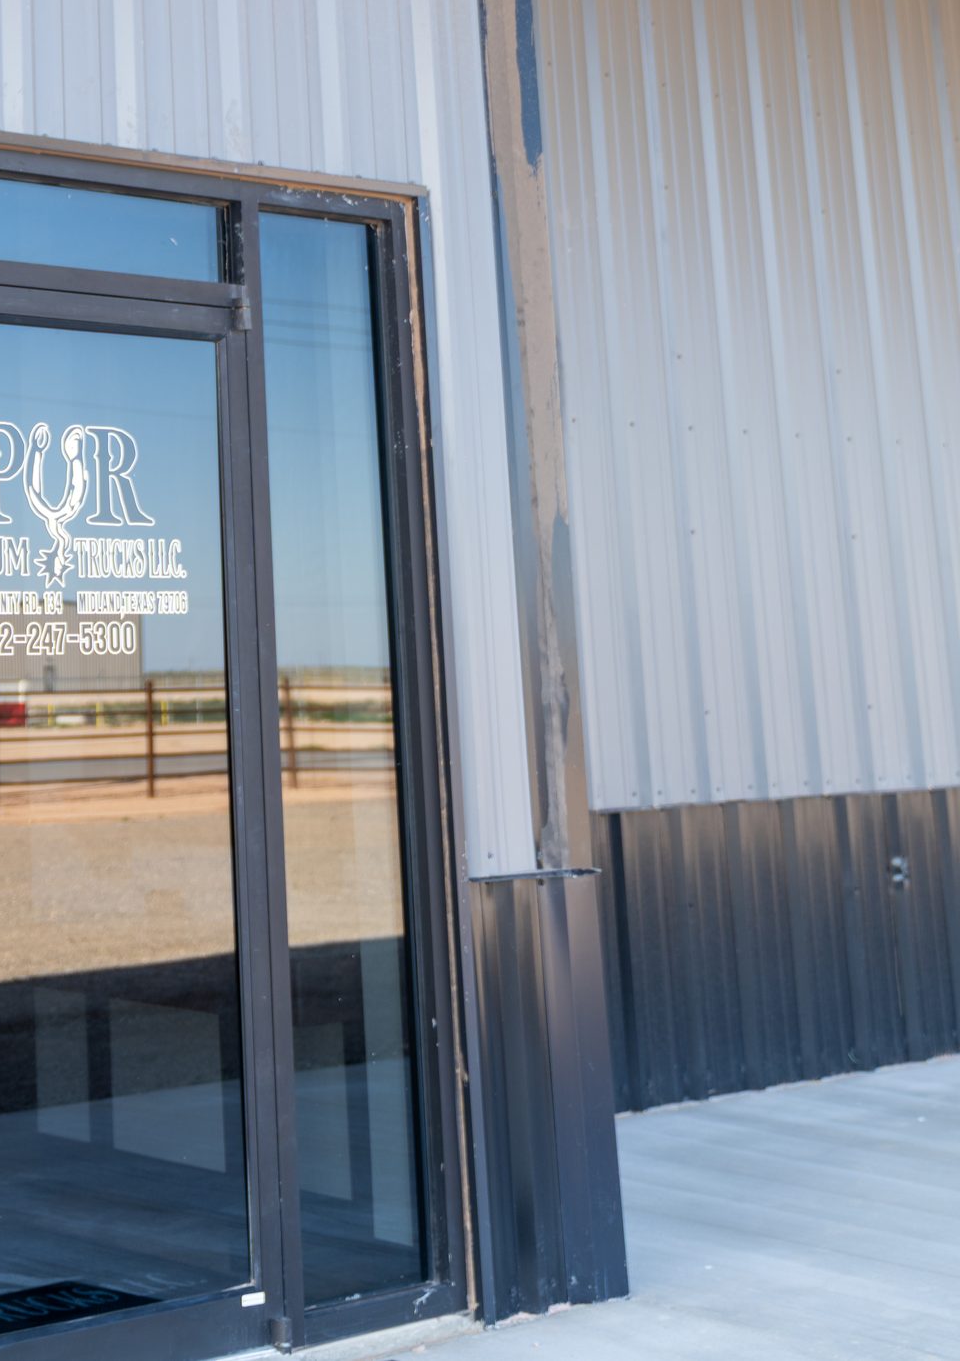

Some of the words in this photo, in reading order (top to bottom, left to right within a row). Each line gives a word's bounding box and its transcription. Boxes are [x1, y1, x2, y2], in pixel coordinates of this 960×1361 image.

[73, 538, 147, 579] TRUCKS
[147, 539, 188, 579] LLC.
[22, 591, 42, 615] RD.
[43, 591, 64, 615] 134
[156, 590, 188, 615] 79706
